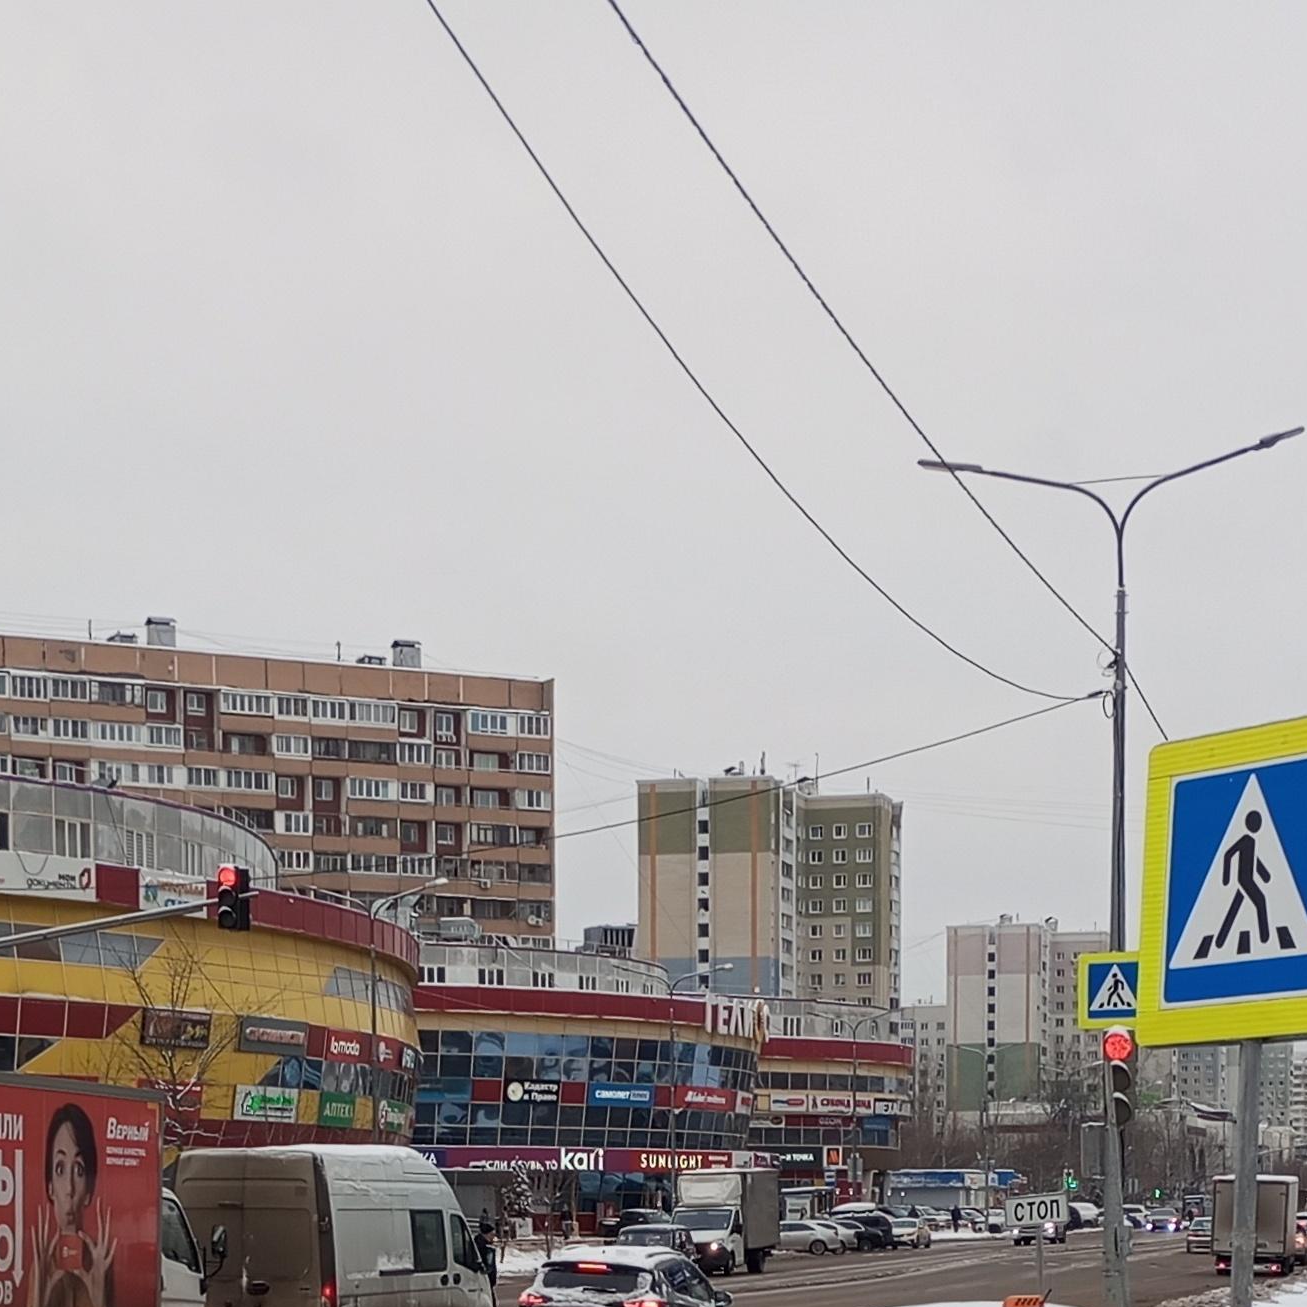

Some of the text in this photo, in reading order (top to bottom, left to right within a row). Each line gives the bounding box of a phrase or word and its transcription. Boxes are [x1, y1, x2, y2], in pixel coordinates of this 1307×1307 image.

[330, 1036, 361, 1057] lamoda
[523, 1081, 558, 1092] Кадастр
[561, 1148, 605, 1171] kari
[640, 1153, 703, 1169] SUNLIGHT
[1014, 1199, 1061, 1222] СТОП
